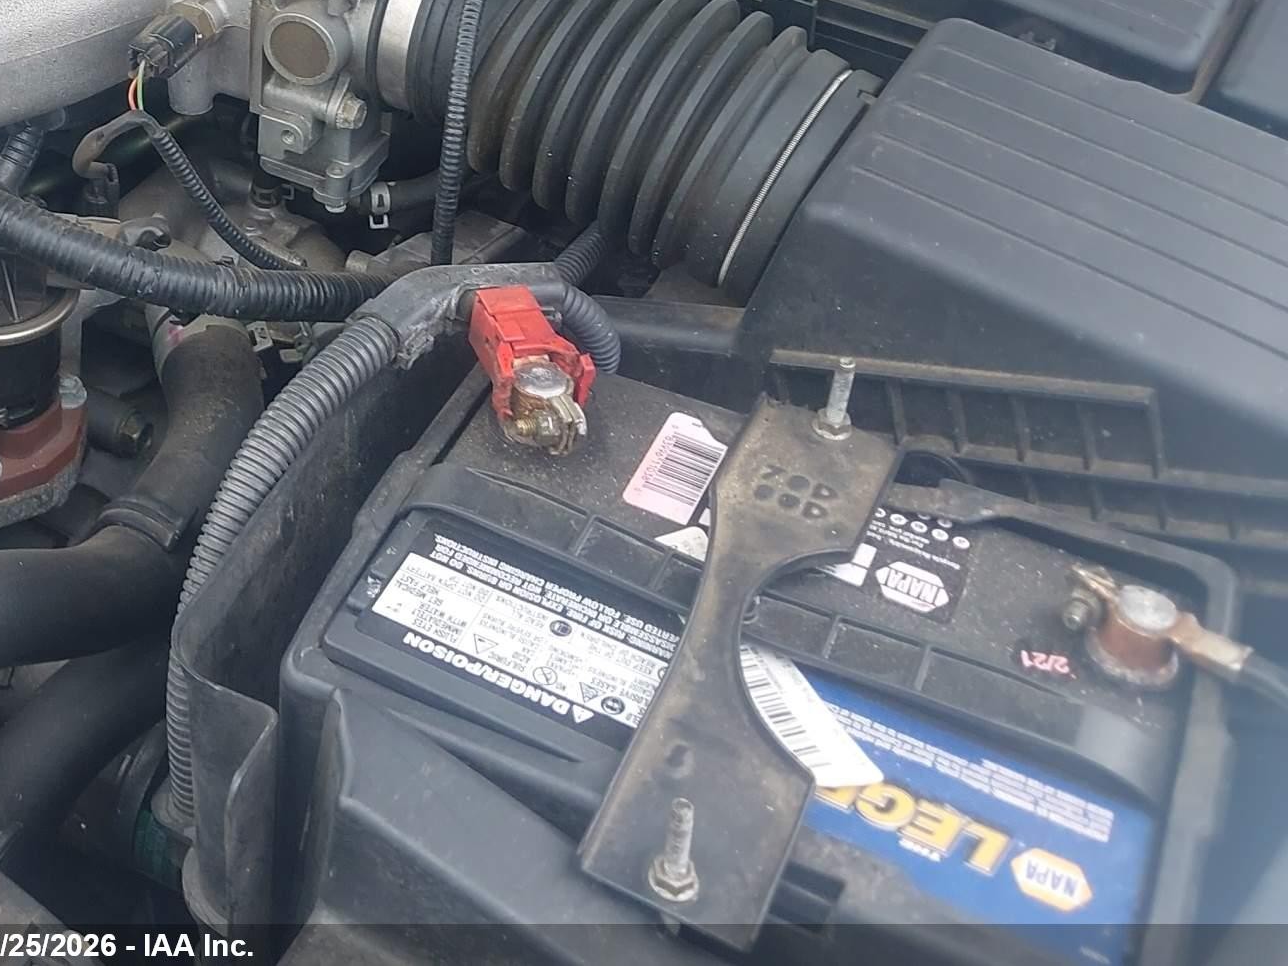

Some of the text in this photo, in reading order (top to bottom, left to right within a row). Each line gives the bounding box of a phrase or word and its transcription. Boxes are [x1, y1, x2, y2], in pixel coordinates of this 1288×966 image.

[884, 569, 938, 602] NAPA
[401, 630, 571, 715] DANGER/POISON
[1018, 649, 1070, 673] 2/21
[1021, 859, 1079, 898] NAPA
